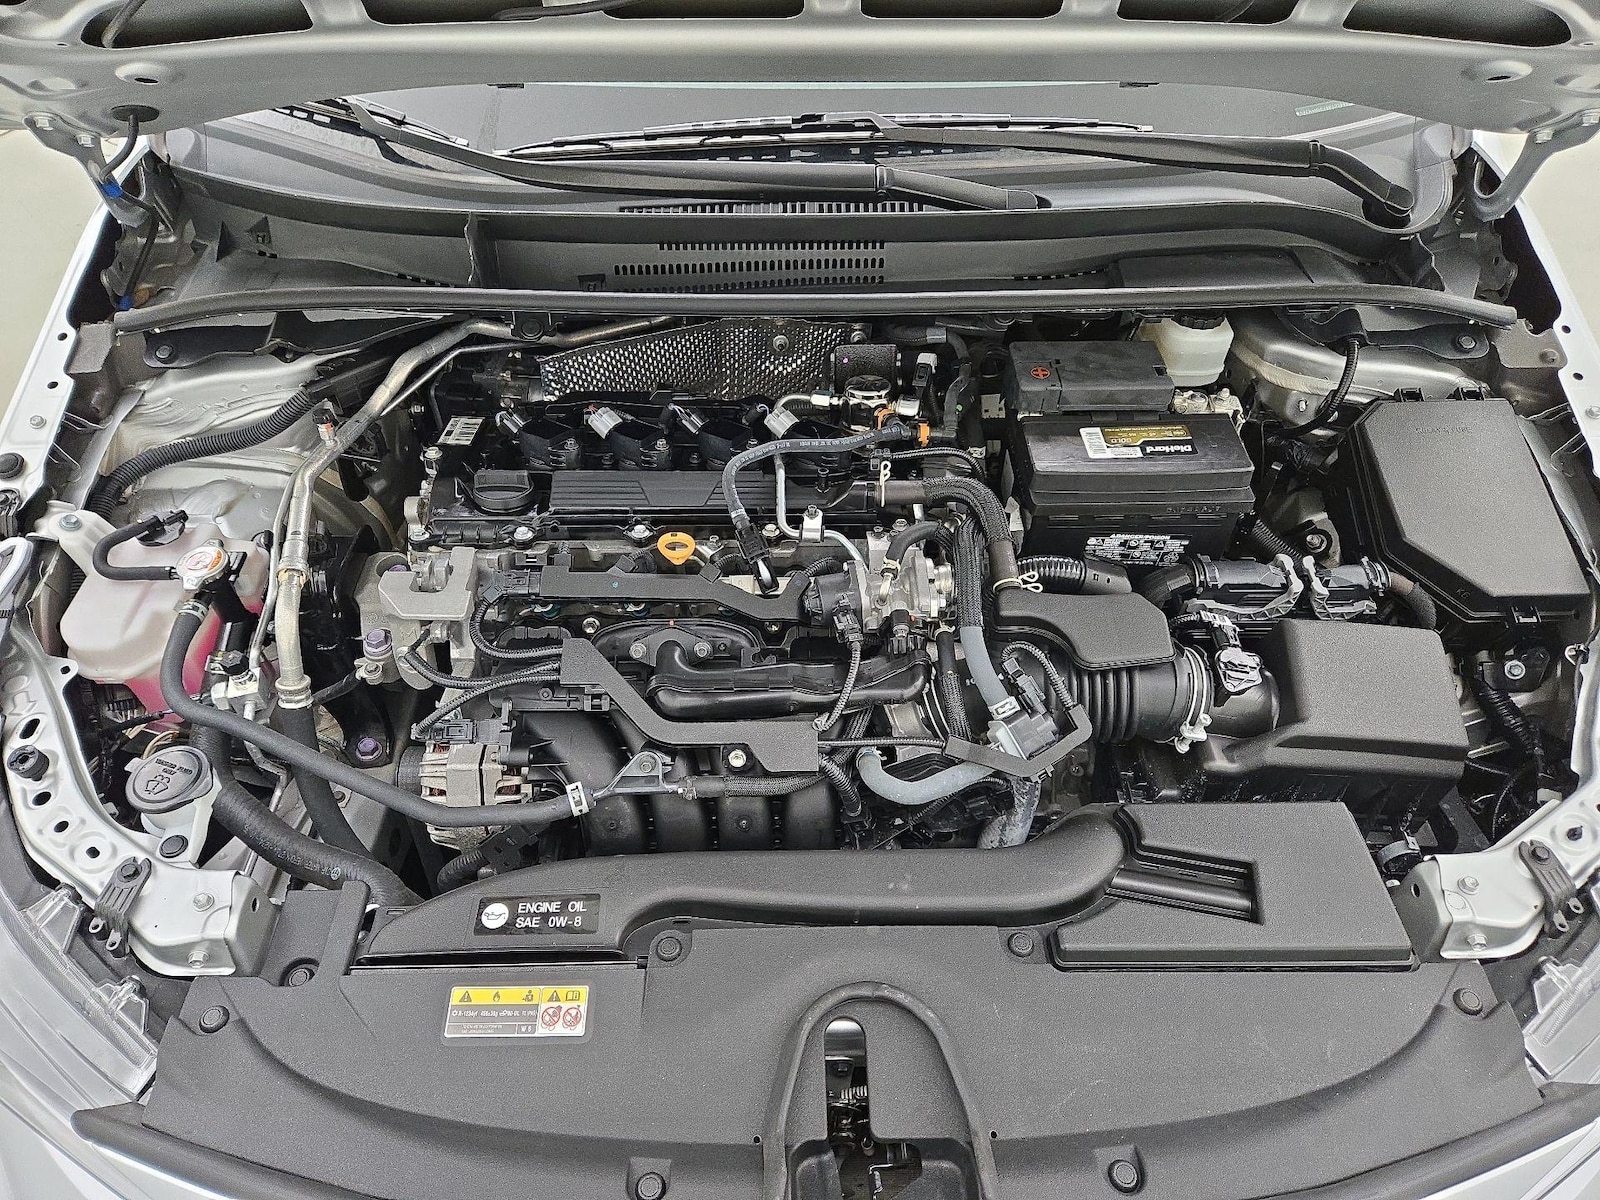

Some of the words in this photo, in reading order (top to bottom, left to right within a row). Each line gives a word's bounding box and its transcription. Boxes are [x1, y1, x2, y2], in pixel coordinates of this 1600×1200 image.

[1145, 445, 1193, 453] DieHard
[518, 901, 561, 913] ENGINE
[567, 901, 587, 912] OIL
[515, 916, 541, 928] SAE
